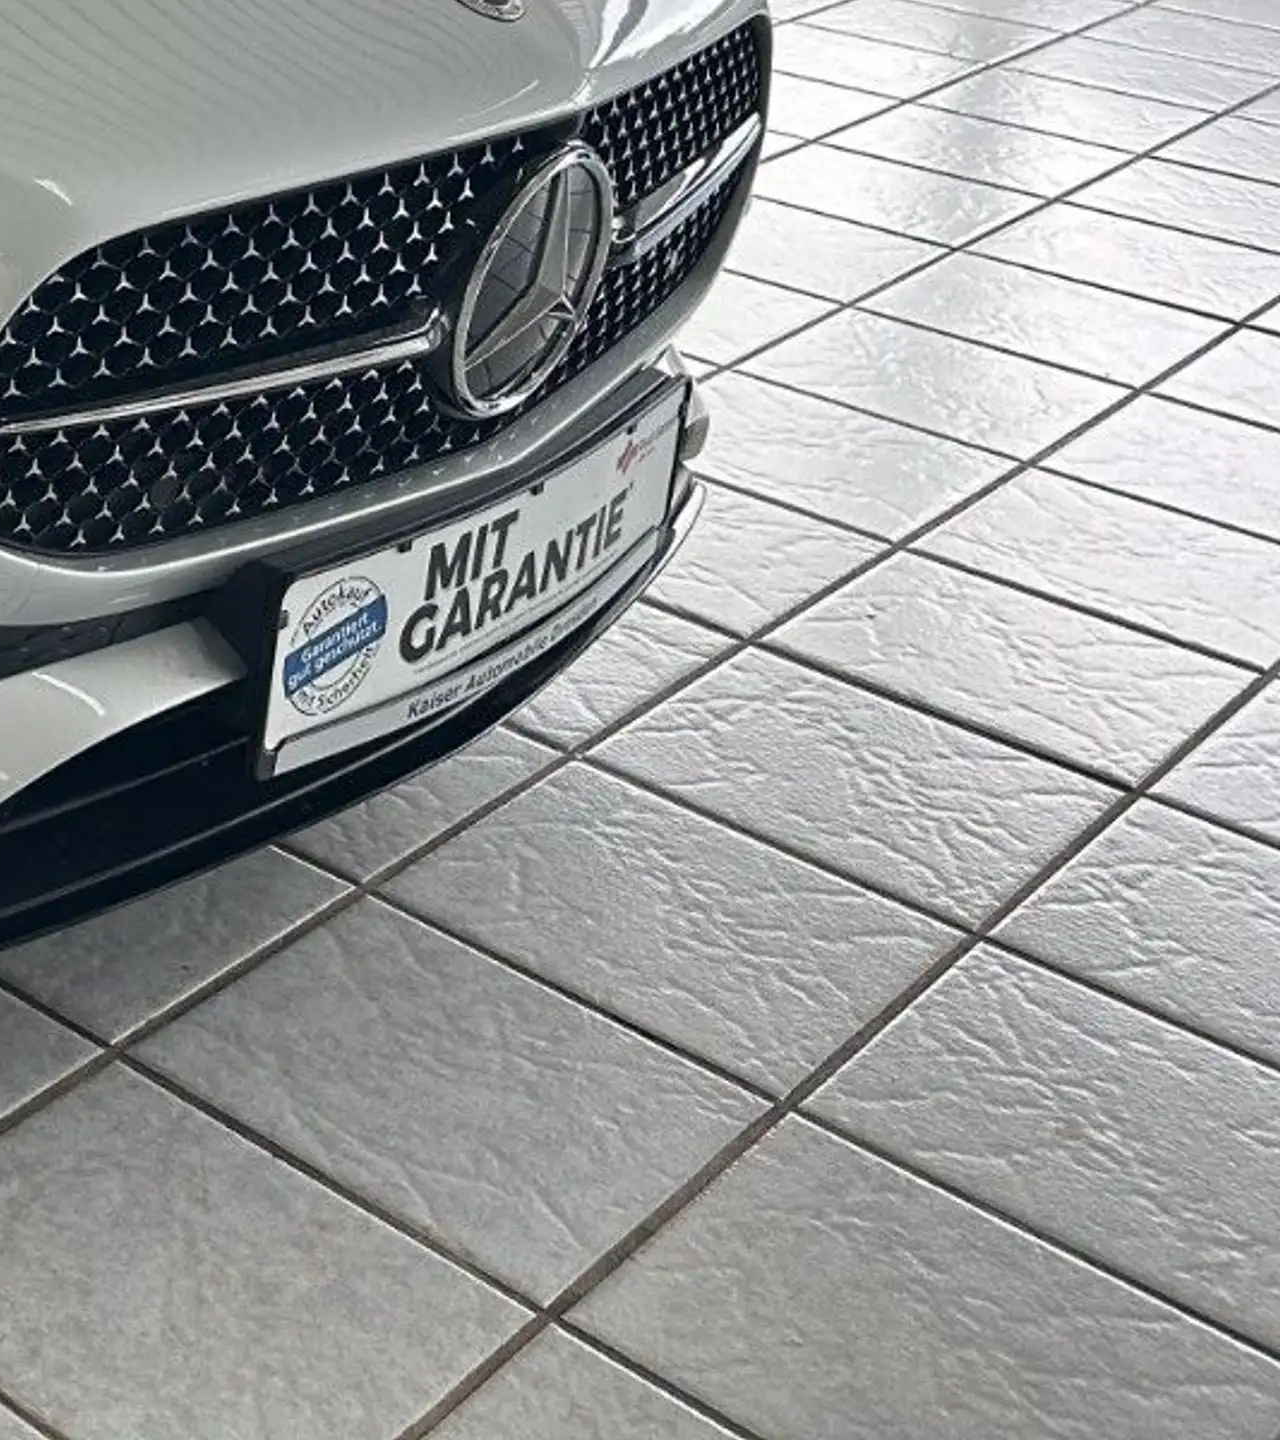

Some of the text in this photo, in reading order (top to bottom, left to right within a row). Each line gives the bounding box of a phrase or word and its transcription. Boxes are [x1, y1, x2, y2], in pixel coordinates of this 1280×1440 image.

[399, 487, 628, 663] GARANTIE
[425, 509, 520, 601] MIT
[408, 683, 465, 719] Kaiser
